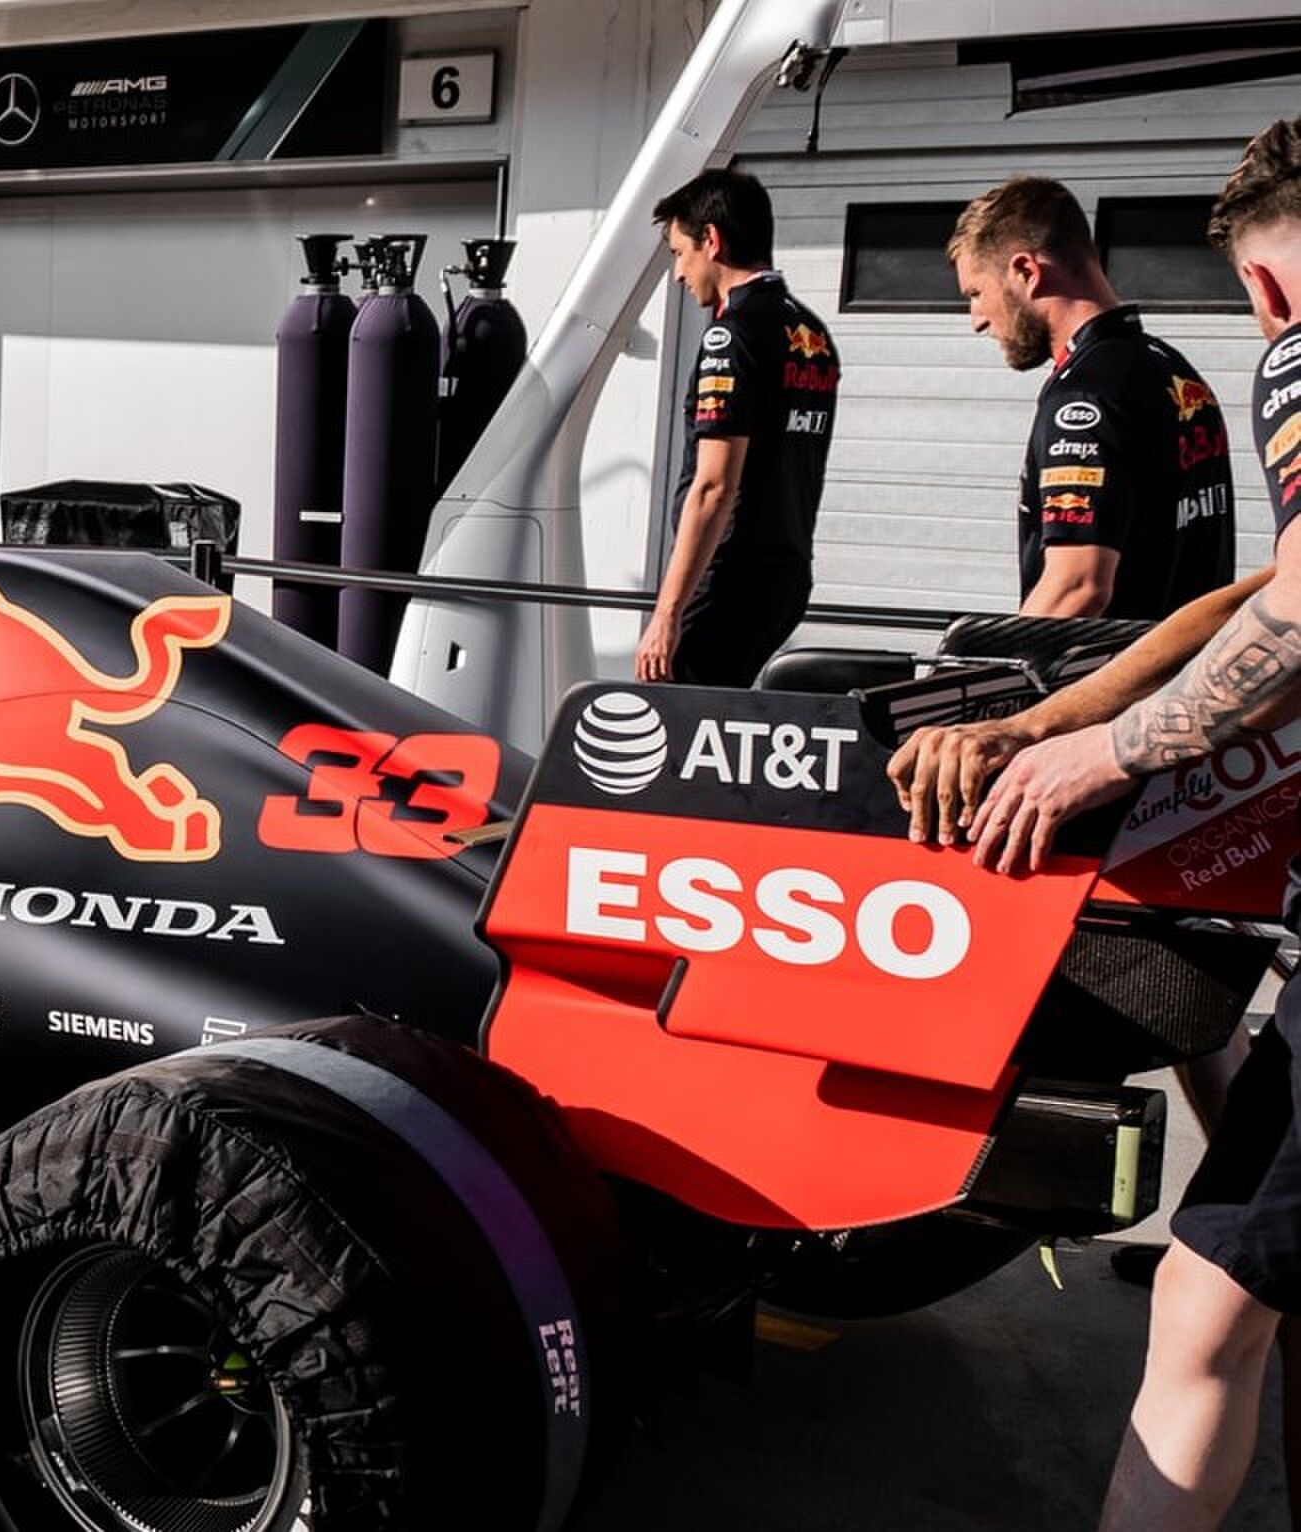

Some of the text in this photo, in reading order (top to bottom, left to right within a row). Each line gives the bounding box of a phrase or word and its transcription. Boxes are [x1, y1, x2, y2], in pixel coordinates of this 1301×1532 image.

[68, 111, 166, 130] MOTORSPORT
[431, 65, 460, 110] 6
[257, 723, 501, 859] 33
[680, 719, 858, 792] AT&T
[1127, 771, 1214, 832] simply
[1167, 786, 1299, 867] ORGANICS
[1179, 831, 1272, 891] Red Bull
[565, 846, 972, 980] ESSO
[48, 1009, 155, 1046] SIEMENS
[539, 1323, 567, 1414] Left
[557, 1319, 580, 1417] Rear
